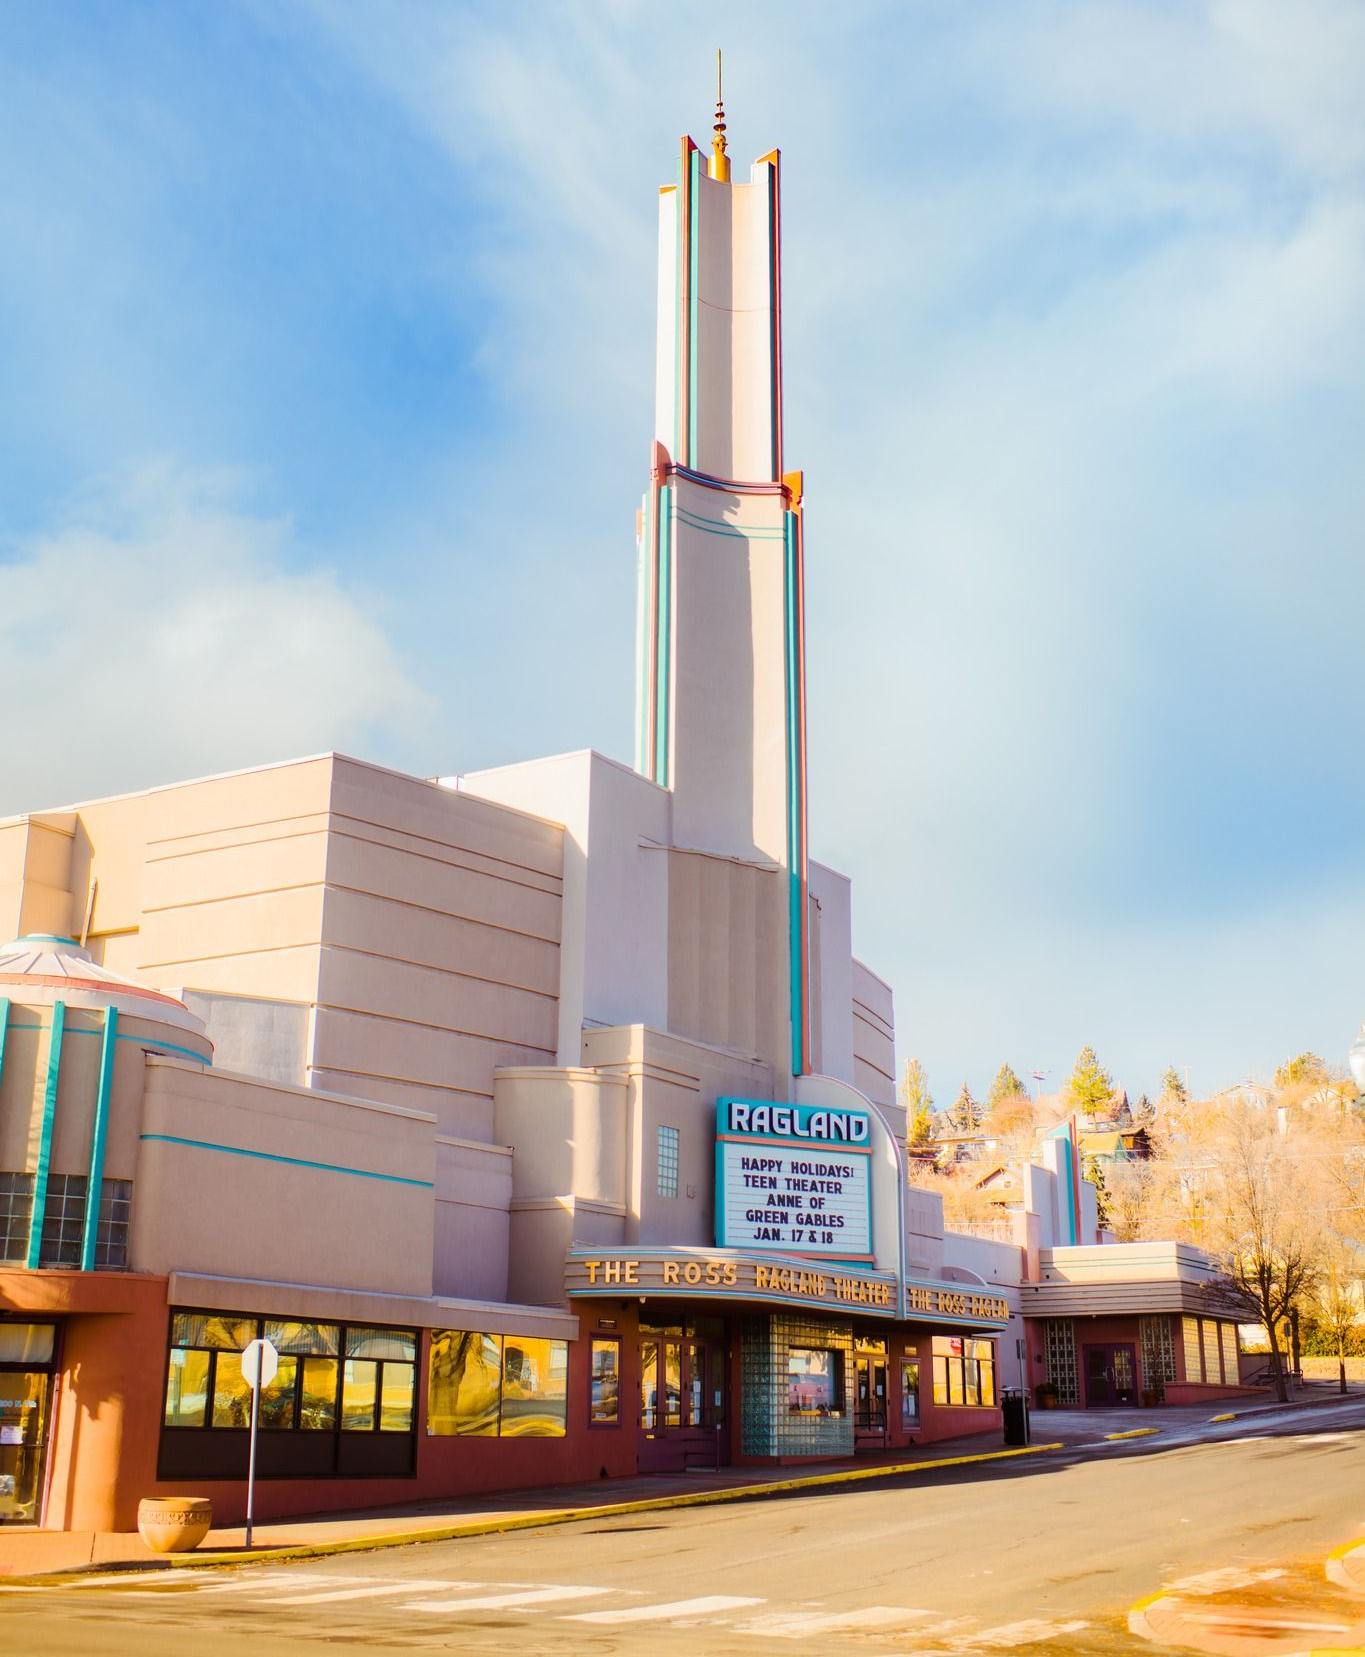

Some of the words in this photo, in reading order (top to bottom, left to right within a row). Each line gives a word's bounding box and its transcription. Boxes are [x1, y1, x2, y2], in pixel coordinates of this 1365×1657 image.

[729, 1103, 868, 1141] RAGLAND
[741, 1157, 783, 1173] HAPPY
[791, 1161, 854, 1178] HOLIDAYS!
[743, 1175, 777, 1190] TEEN
[785, 1178, 843, 1194] THEATER
[766, 1194, 803, 1208] ANNE
[809, 1197, 826, 1210] OF
[745, 1210, 789, 1225] GREEN
[795, 1213, 845, 1228] GABLES
[753, 1227, 786, 1242] JAN.
[791, 1229, 804, 1243] 17
[808, 1230, 817, 1244] &
[821, 1231, 834, 1245] 18
[585, 1260, 640, 1285] THE
[663, 1260, 738, 1287] ROSS
[756, 1264, 825, 1298] RAGLAND
[833, 1276, 890, 1306] THEATER
[910, 1288, 933, 1312] THE
[936, 1292, 966, 1315] ROSS
